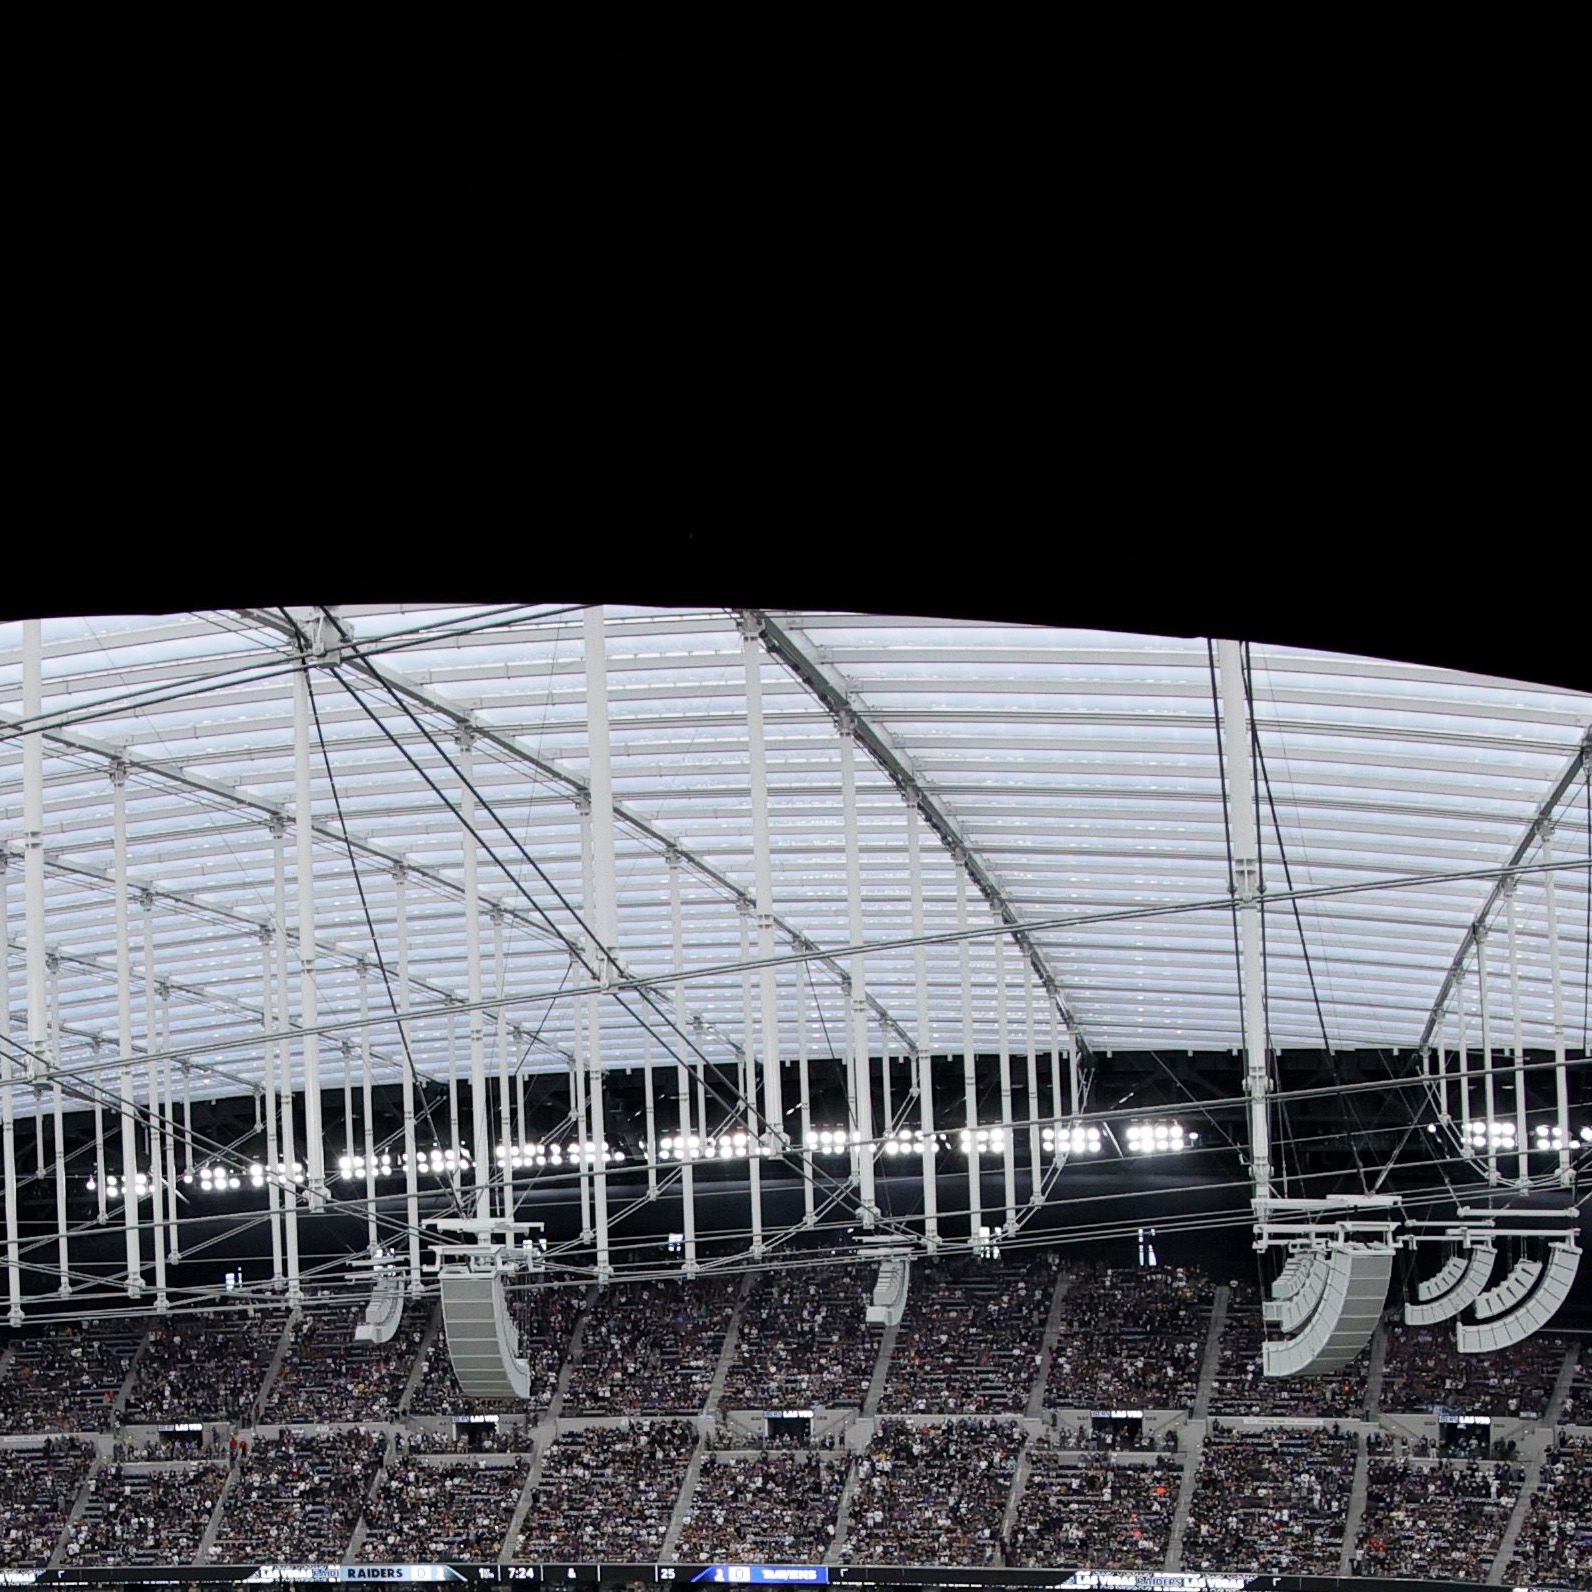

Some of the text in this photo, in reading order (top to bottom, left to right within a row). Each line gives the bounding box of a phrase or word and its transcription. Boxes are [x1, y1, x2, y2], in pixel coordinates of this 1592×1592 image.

[348, 1568, 403, 1579] RAIDERS
[508, 1568, 534, 1579] 7:24
[661, 1568, 676, 1579] 25
[1076, 1575, 1244, 1588] LAS VEGAS RAIDERS LAS VEGAS
